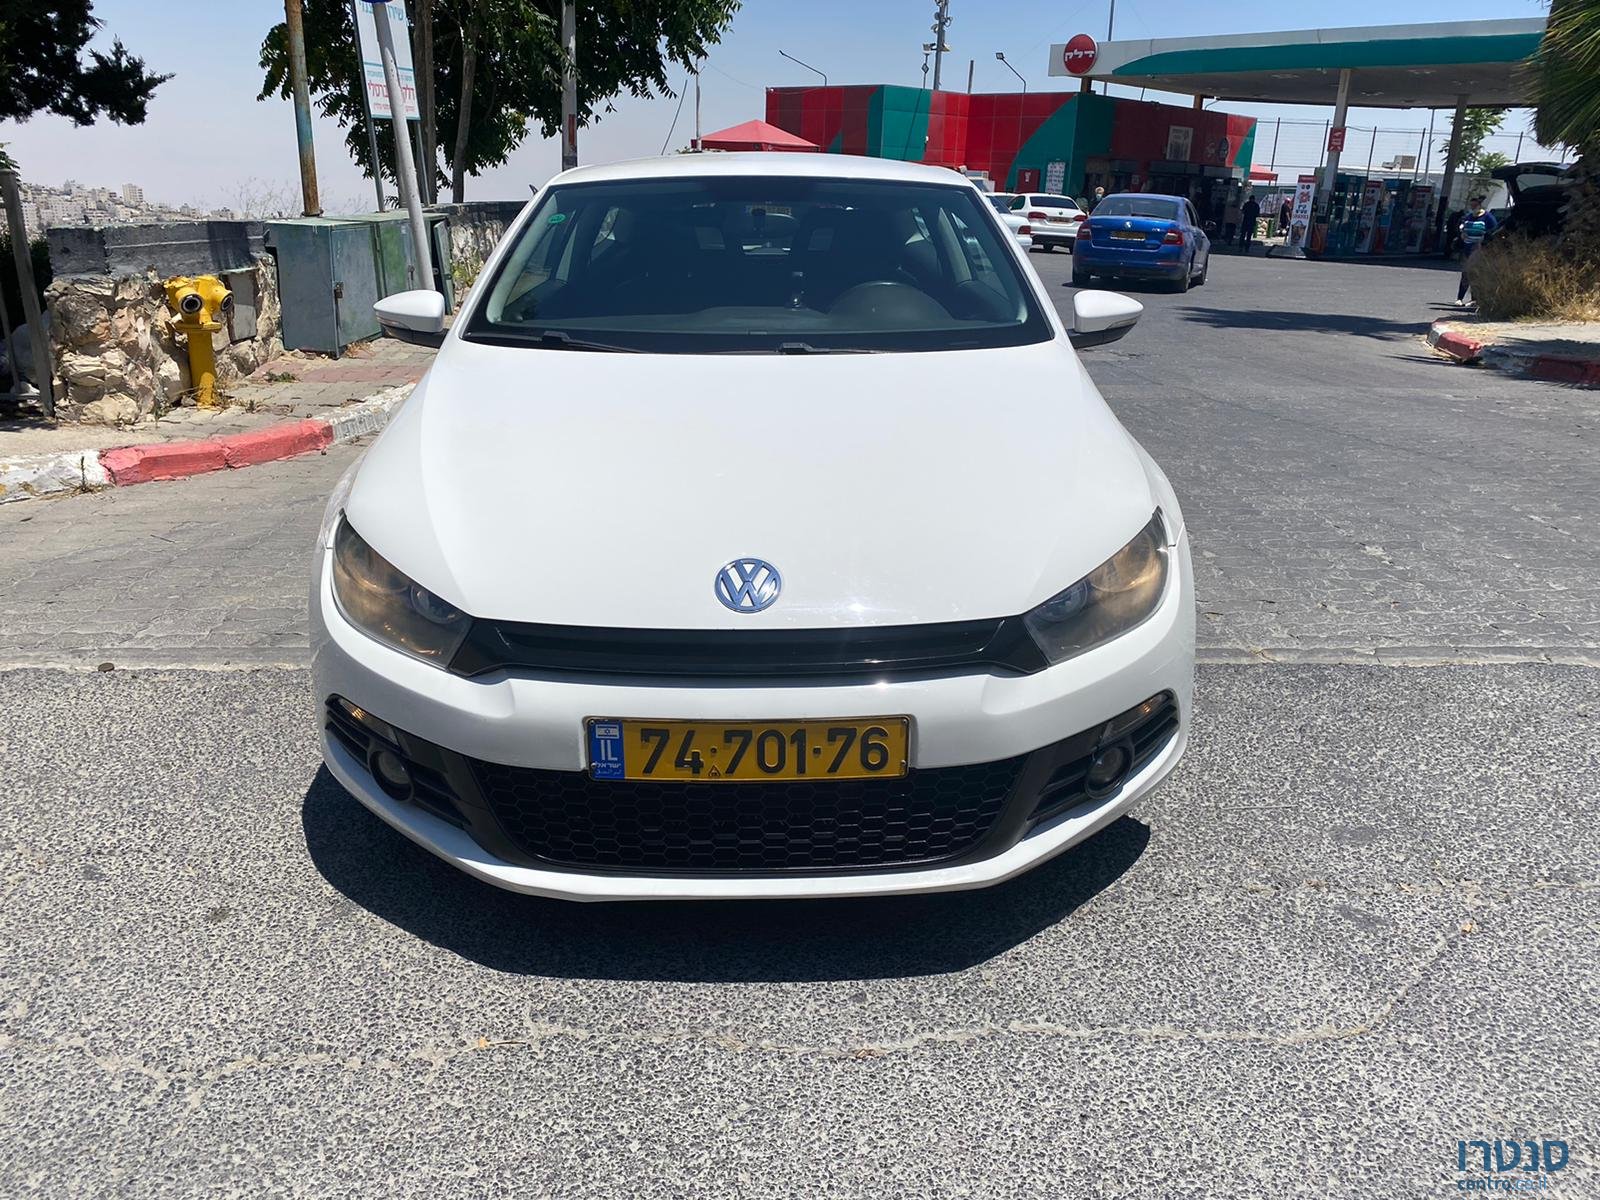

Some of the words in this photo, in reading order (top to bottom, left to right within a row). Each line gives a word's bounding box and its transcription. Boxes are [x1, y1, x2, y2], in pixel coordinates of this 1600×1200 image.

[1064, 48, 1095, 62] דלק
[715, 558, 781, 613] VW
[600, 739, 618, 761] IL
